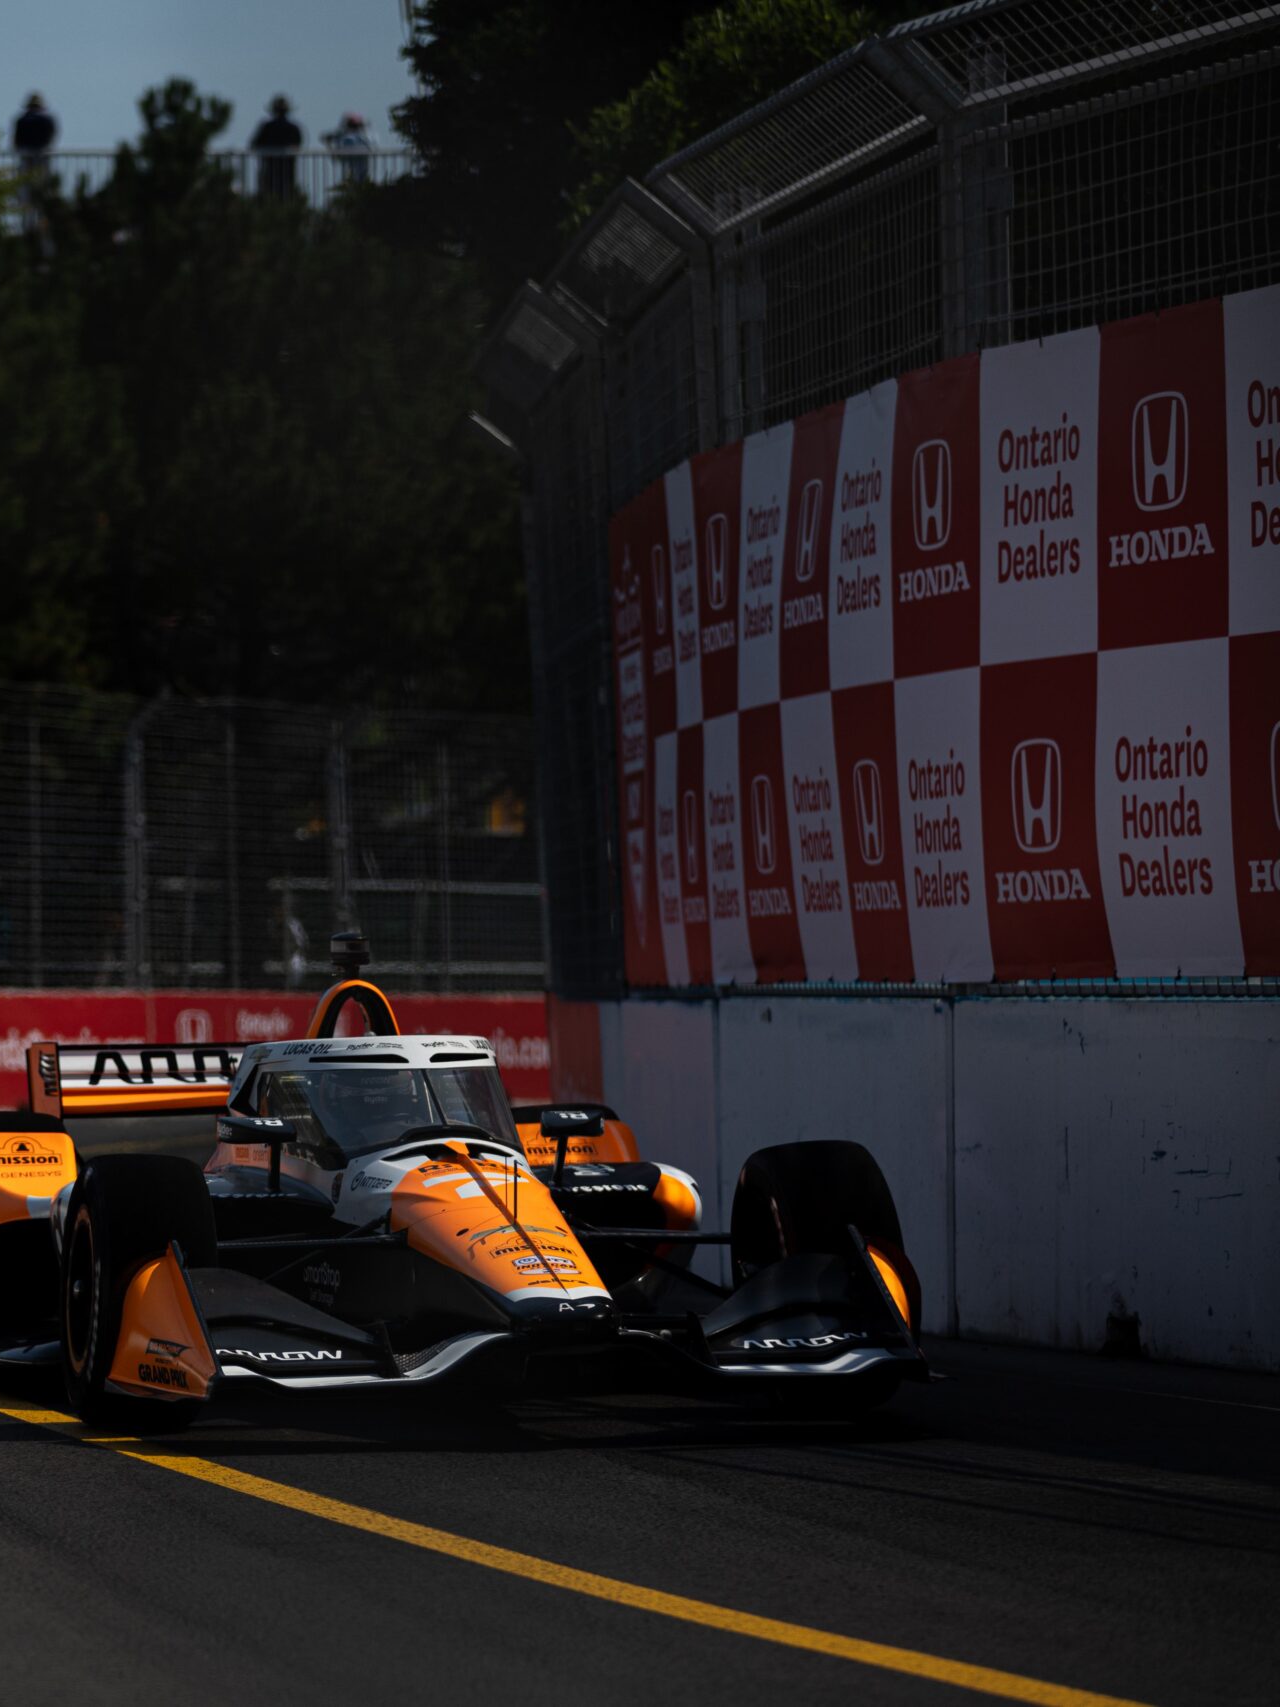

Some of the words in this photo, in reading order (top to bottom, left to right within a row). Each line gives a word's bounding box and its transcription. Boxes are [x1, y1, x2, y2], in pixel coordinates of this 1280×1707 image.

[998, 412, 1080, 473] Ontario
[841, 457, 881, 513] Ontario
[1004, 471, 1074, 528] Honda
[747, 495, 780, 544] Ontario
[840, 512, 876, 563] Honda
[998, 529, 1080, 584] Dealers
[1108, 523, 1216, 568] HONDA
[746, 547, 773, 592] Honda
[837, 566, 881, 616] Dealers
[899, 561, 970, 604] HONDA
[744, 596, 773, 640] Dealers
[784, 592, 824, 630] HONDA
[702, 619, 736, 654] HONDA
[908, 748, 966, 801] Ontario
[1115, 725, 1208, 783] Ontario
[793, 767, 831, 814] Ontario
[1122, 785, 1202, 839] Honda
[799, 818, 833, 863] Honda
[914, 804, 962, 853] Honda
[801, 868, 843, 913] Dealers
[914, 860, 970, 908] Dealers
[995, 868, 1092, 904] HONDA
[1119, 846, 1213, 898] Dealers
[748, 887, 792, 917] HONDA
[852, 880, 902, 912] HONDA
[283, 1043, 313, 1056] LUCAS
[313, 1043, 333, 1056] OIL
[0, 1170, 62, 1178] GENESYS
[138, 1363, 170, 1385] GRAND
[170, 1367, 188, 1389] PRIX
[214, 1348, 343, 1361] ARROW
